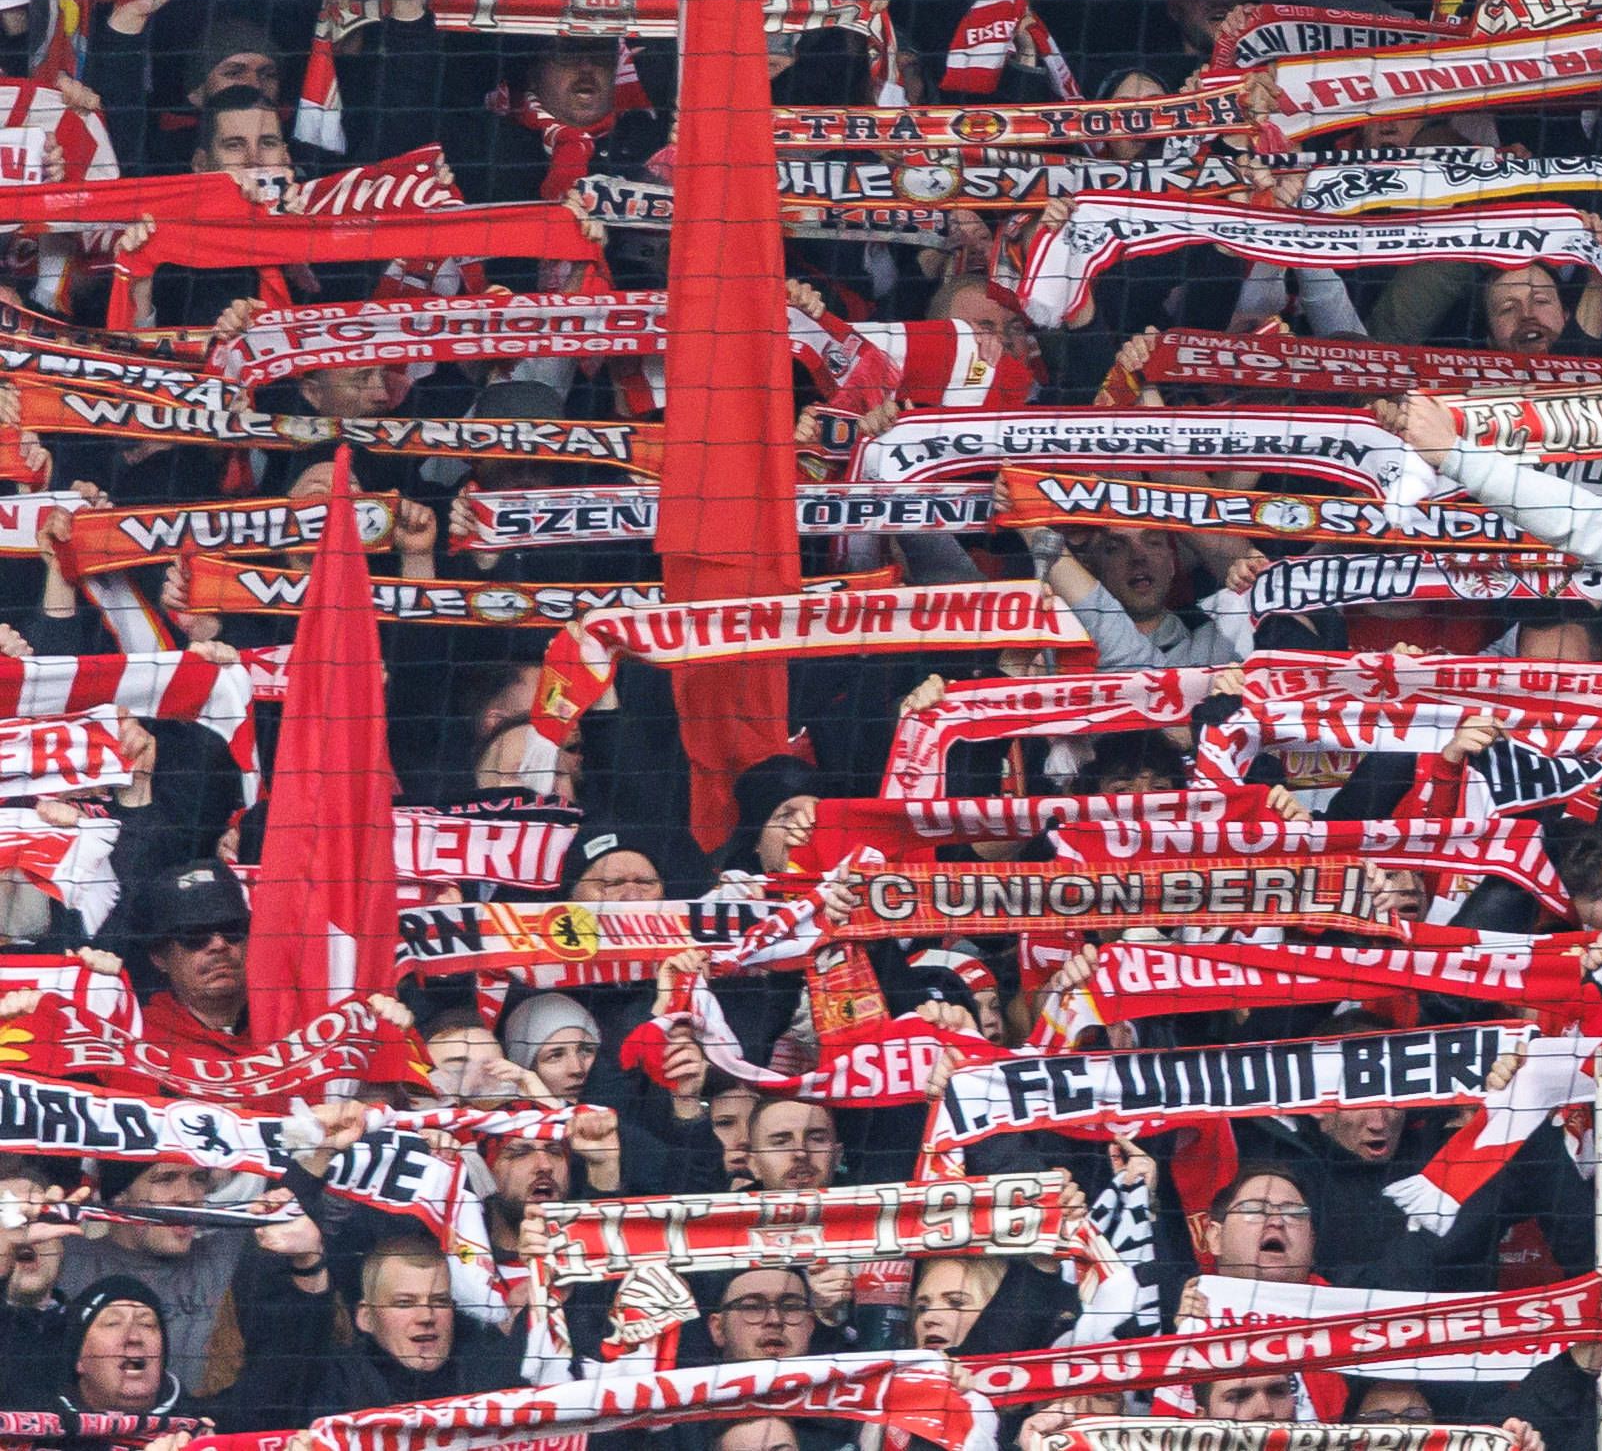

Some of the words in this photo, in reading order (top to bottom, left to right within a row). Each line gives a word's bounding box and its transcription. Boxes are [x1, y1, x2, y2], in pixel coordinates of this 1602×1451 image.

[1040, 83, 1245, 139] YOUTH
[1207, 221, 1261, 238] Jetzt
[1264, 224, 1302, 238] erst
[1306, 225, 1362, 239] recht
[1369, 227, 1406, 238] zum
[401, 309, 579, 341] Union
[1161, 331, 1252, 354] EINMAL
[1279, 339, 1404, 366] UNIONER
[1422, 351, 1519, 371] IMMER
[1163, 364, 1306, 388] JETZT
[64, 391, 277, 442] WUHLE
[1002, 423, 1058, 438] Jetzt
[1062, 424, 1106, 438] erst
[1112, 424, 1174, 438] recht
[1178, 425, 1222, 438] zum
[999, 434, 1176, 457] UNION
[1184, 435, 1372, 468] BERLIN
[1038, 475, 1254, 528] WUHLE
[1249, 553, 1424, 614] UNION
[798, 590, 898, 638] FÜR
[904, 790, 1230, 839] UNIONER
[931, 871, 1145, 919] UNION
[598, 913, 688, 948] UNION
[1009, 1058, 1095, 1119] FC
[1118, 1044, 1320, 1113] UNION
[1071, 1351, 1153, 1385] DU
[1165, 1327, 1321, 1377] AUCH
[1331, 1291, 1592, 1353] SPIELST
